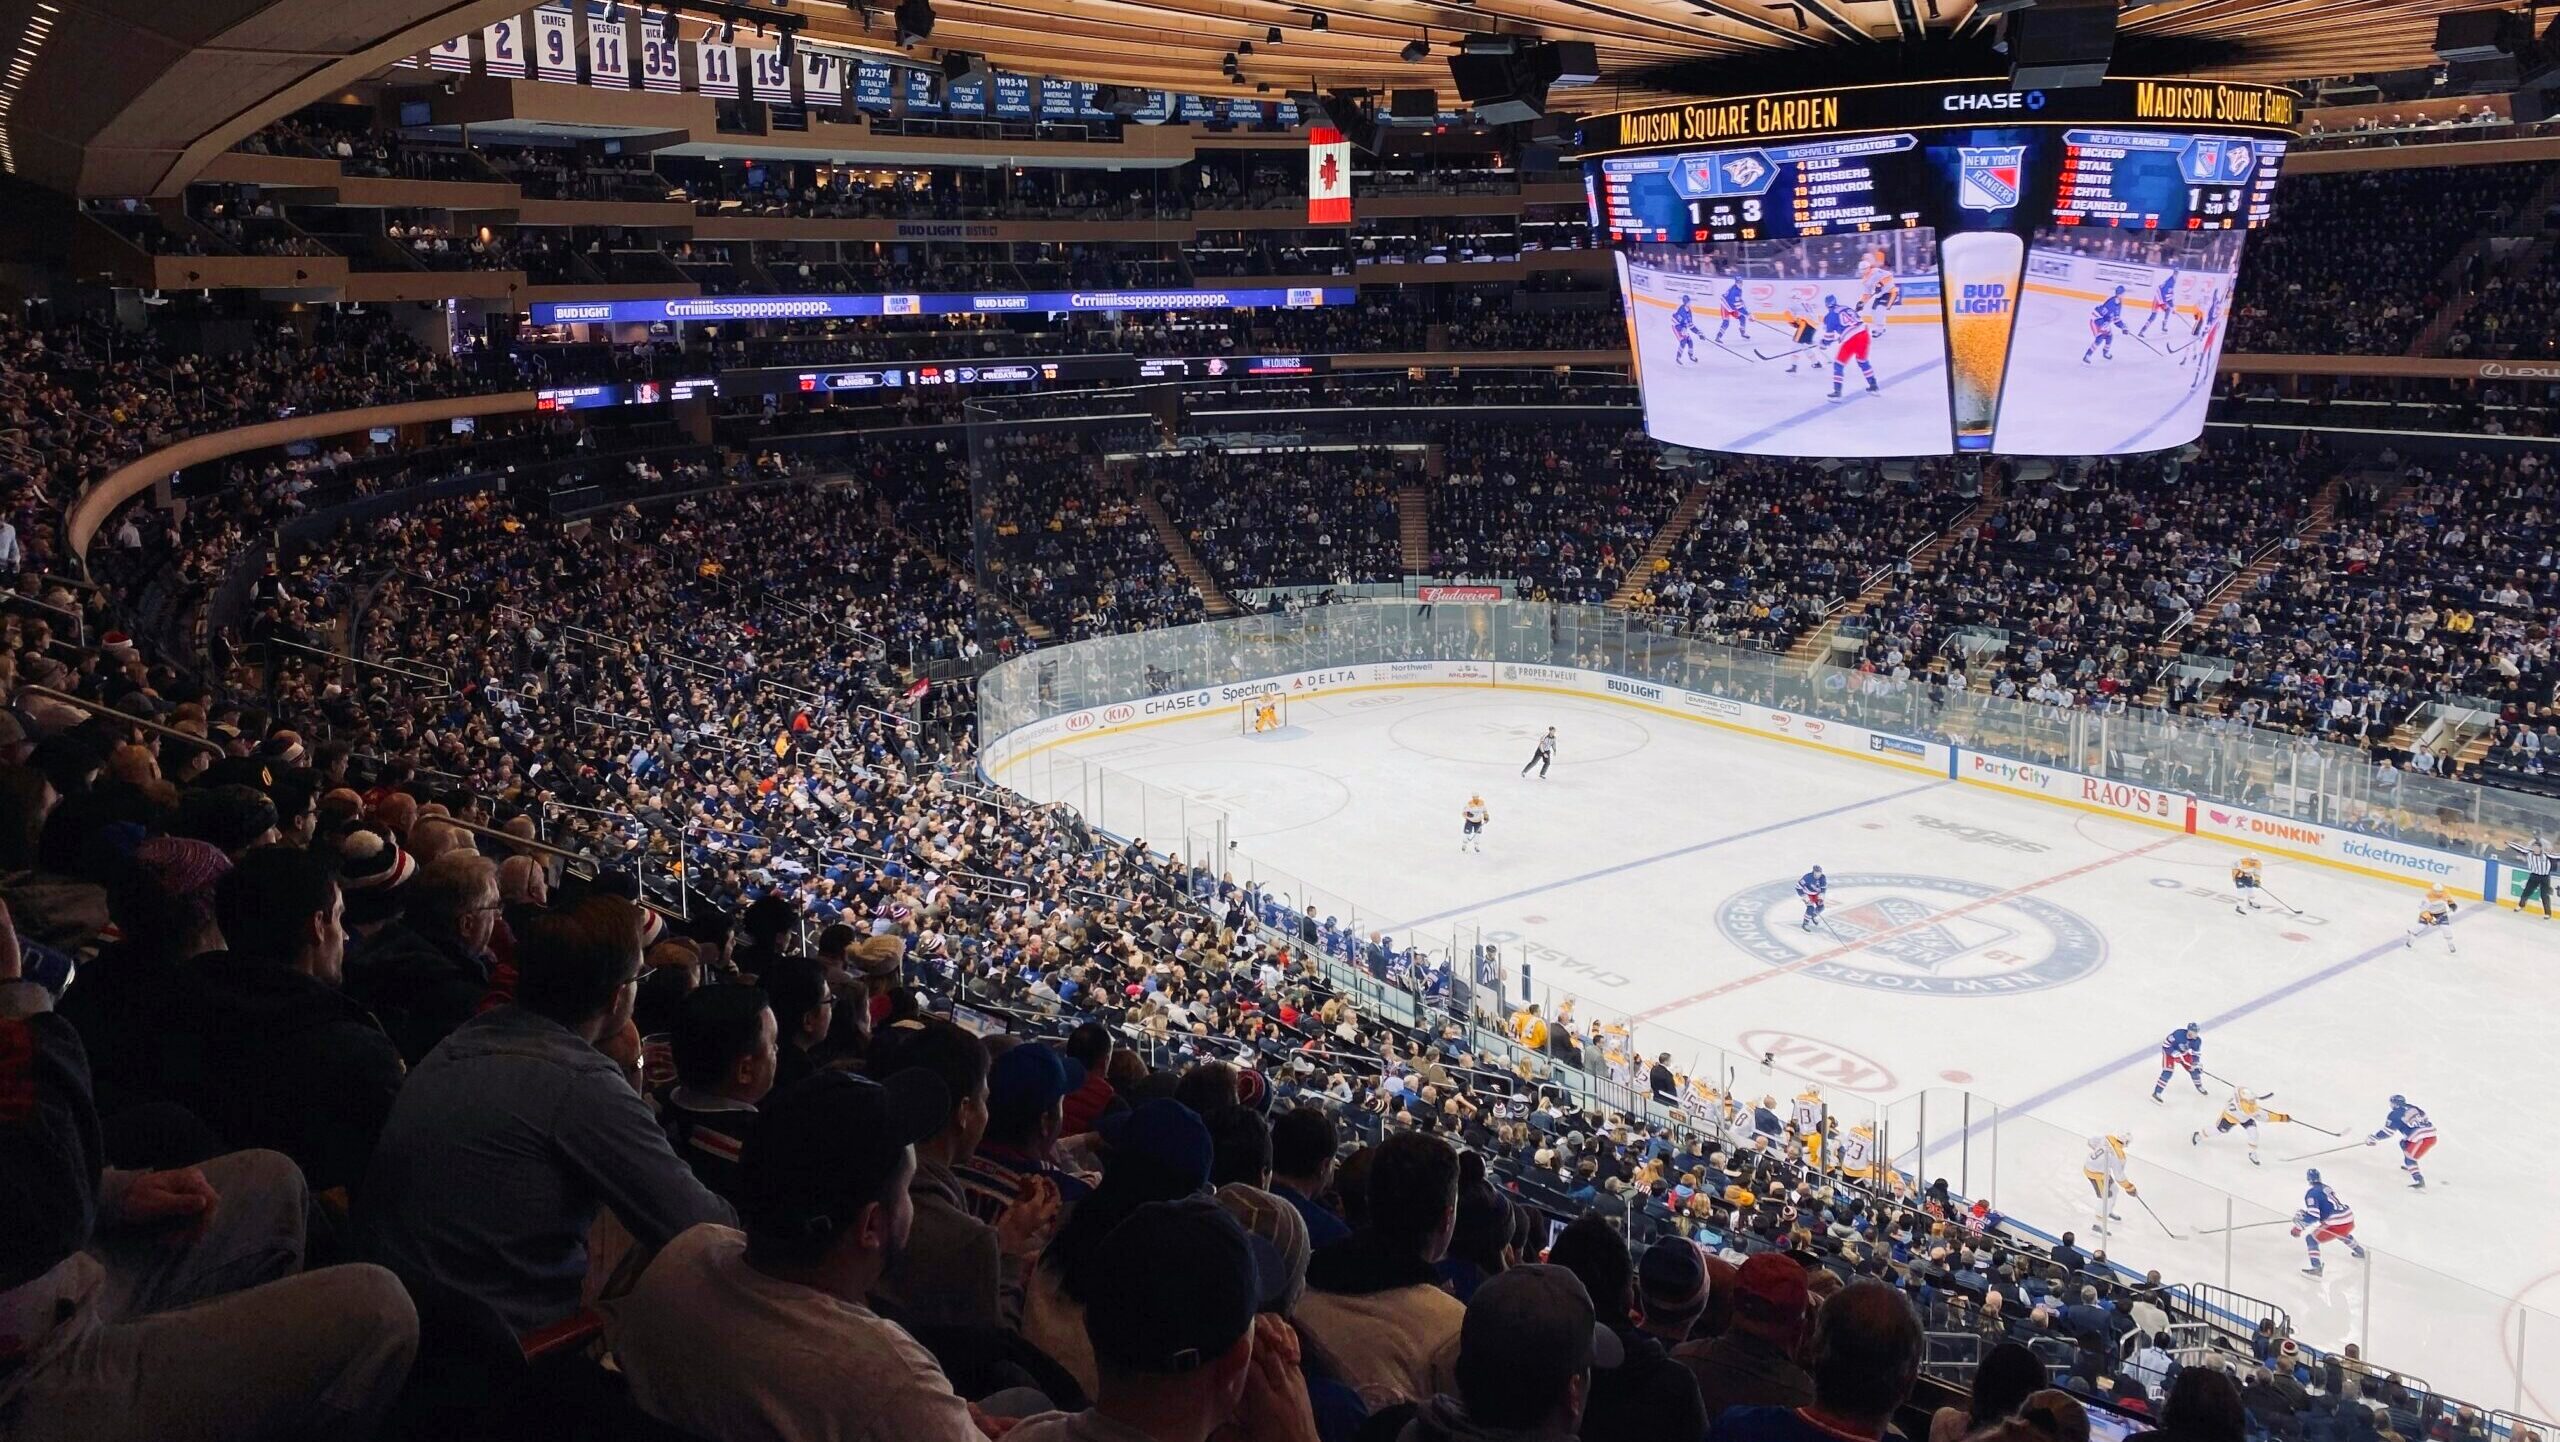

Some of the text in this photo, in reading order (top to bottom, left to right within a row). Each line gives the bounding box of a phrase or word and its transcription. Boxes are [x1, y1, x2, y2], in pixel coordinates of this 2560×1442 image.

[542, 15, 566, 28] GRAVES
[593, 24, 621, 36] MESSIER
[646, 28, 661, 38] RICH
[495, 23, 512, 59] 2
[548, 30, 563, 65] 9
[596, 37, 622, 73] 11
[644, 42, 676, 77] 35
[705, 48, 730, 82] 11
[757, 53, 785, 87] 19
[860, 79, 886, 89] STANLEY
[997, 78, 1028, 88] 1993-94
[954, 86, 979, 95] STANLEY
[1000, 88, 1025, 97] STANLEY
[1043, 91, 1071, 99] AMERICAN
[857, 95, 891, 105] CHAMPIONS
[951, 101, 984, 111] CHAMPIONS
[1944, 93, 2022, 110] CHASE
[2137, 82, 2212, 119] MADISON
[2216, 85, 2263, 123] SQUARE
[997, 104, 1030, 112] CHAMPIONS
[1042, 106, 1074, 114] CHAMPIONS
[1229, 110, 1262, 118] CHAMPIONS
[1233, 104, 1257, 112] DIVISION
[1620, 97, 1838, 145] MADISON SQUARE GARDEN
[2090, 135, 2170, 147] NEW YORK RANGERS
[1788, 139, 1897, 158] NASHVILLE PREDATORS
[2080, 148, 2126, 158] MCKEGG
[1807, 159, 1840, 170] ELLIS
[1967, 155, 2017, 166] NEW YORK
[2078, 160, 2113, 171] STAAL
[1807, 168, 1870, 182] FORSBERG
[2076, 174, 2111, 184] SMITH
[1809, 181, 1874, 195] JARNKROK
[1973, 170, 2014, 202] RANGERS
[2074, 187, 2112, 198] CHYTIL
[1810, 197, 1837, 207] JOSI
[2072, 200, 2127, 211] DEANGELO
[2189, 189, 2201, 211] 1
[2227, 189, 2241, 212] 3
[1688, 203, 1700, 224] 1
[1743, 200, 1761, 221] 3
[1811, 206, 1875, 219] JOHANSEN
[1710, 215, 1735, 226] 3:10
[898, 225, 998, 236] BUD LIGHT DISTRICT
[1695, 230, 1708, 240] 27
[1964, 284, 2005, 298] BUD
[890, 297, 909, 305] BUD
[976, 298, 1026, 308] BUD LIGHT
[1955, 299, 2011, 313] LIGHT
[556, 307, 609, 318] BUD LIGHT
[1262, 358, 1300, 368] THE LOUNGES
[907, 371, 916, 385] 1
[944, 369, 955, 383] 3
[983, 371, 1028, 380] PREDATORS
[2505, 367, 2560, 378] LEXU
[800, 380, 816, 390] 27
[837, 378, 873, 387] RANGERS
[920, 376, 941, 385] 3:10
[1425, 587, 1495, 601] Budweiser
[1391, 663, 1432, 672] Northwell
[1308, 671, 1355, 686] DELTA
[1519, 668, 1547, 677] PROPER
[1550, 671, 1576, 682] TWELVE
[1222, 682, 1277, 702] Spectrum
[1607, 680, 1661, 700] BUD LIGHT
[1145, 695, 1195, 715] CHASE
[1688, 695, 1738, 712] EMPIRE CITY
[1109, 709, 1130, 719] KIA
[1071, 717, 1090, 728] KIA
[2081, 777, 2151, 813] RAO'S
[2251, 818, 2325, 846] DUNKIN'
[2342, 839, 2454, 876] ticketmaster
[1728, 899, 1794, 963] RANGERS
[1819, 963, 2045, 994] NEW YORK
[1767, 1036, 1882, 1085] KIA
